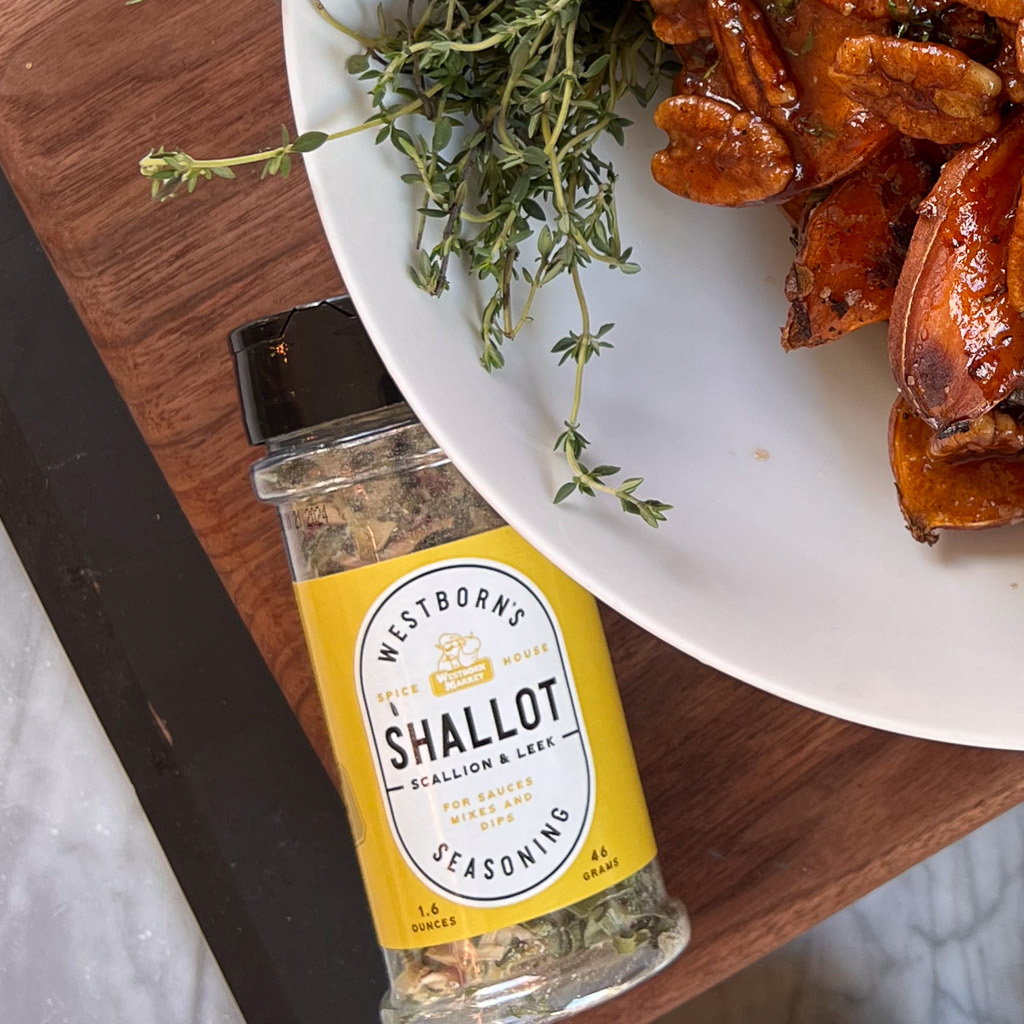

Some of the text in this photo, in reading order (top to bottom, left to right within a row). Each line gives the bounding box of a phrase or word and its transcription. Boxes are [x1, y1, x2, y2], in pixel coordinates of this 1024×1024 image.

[378, 587, 525, 664] WESTBORN'S
[503, 643, 549, 666] HOUSE
[377, 684, 420, 703] SPICE
[385, 677, 558, 770] SHALLOT
[411, 737, 556, 790] SCALLION & LEEK
[443, 776, 533, 812] FOR SAUCES
[450, 792, 532, 825] MIXES AND
[480, 812, 514, 831] DIPS
[433, 807, 570, 880] SEASONING
[591, 845, 608, 862] 46
[583, 857, 620, 881] GRAMS
[418, 902, 440, 918] 1.6
[411, 916, 457, 933] OUNCES
